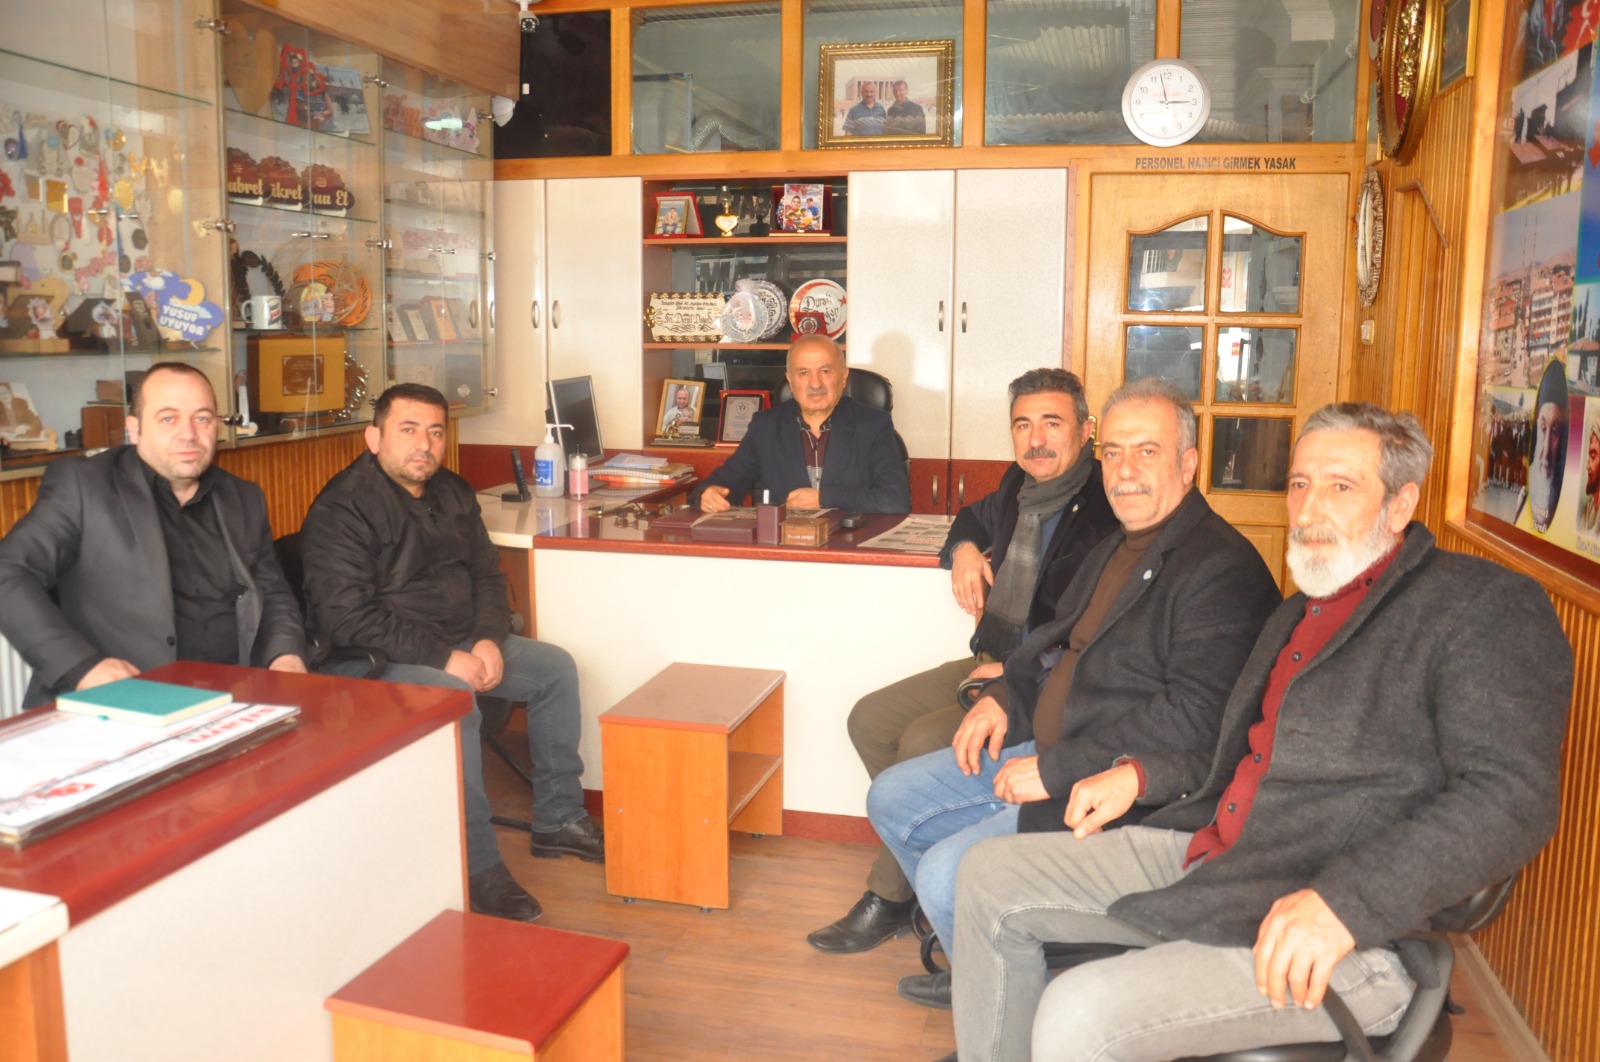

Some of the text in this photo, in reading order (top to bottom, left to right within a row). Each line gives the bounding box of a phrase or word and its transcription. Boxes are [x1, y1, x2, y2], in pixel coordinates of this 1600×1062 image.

[1163, 72, 1172, 80] 12
[1140, 86, 1148, 94] 10
[1188, 84, 1194, 92] 2
[1191, 98, 1197, 106] 3
[1135, 157, 1185, 169] PERSONEL
[1264, 157, 1297, 169] YASAK
[228, 176, 263, 195] abret
[270, 183, 303, 200] ikret
[313, 193, 332, 205] ua
[163, 305, 198, 322] YUSUF
[159, 315, 205, 336] UYUYOR
